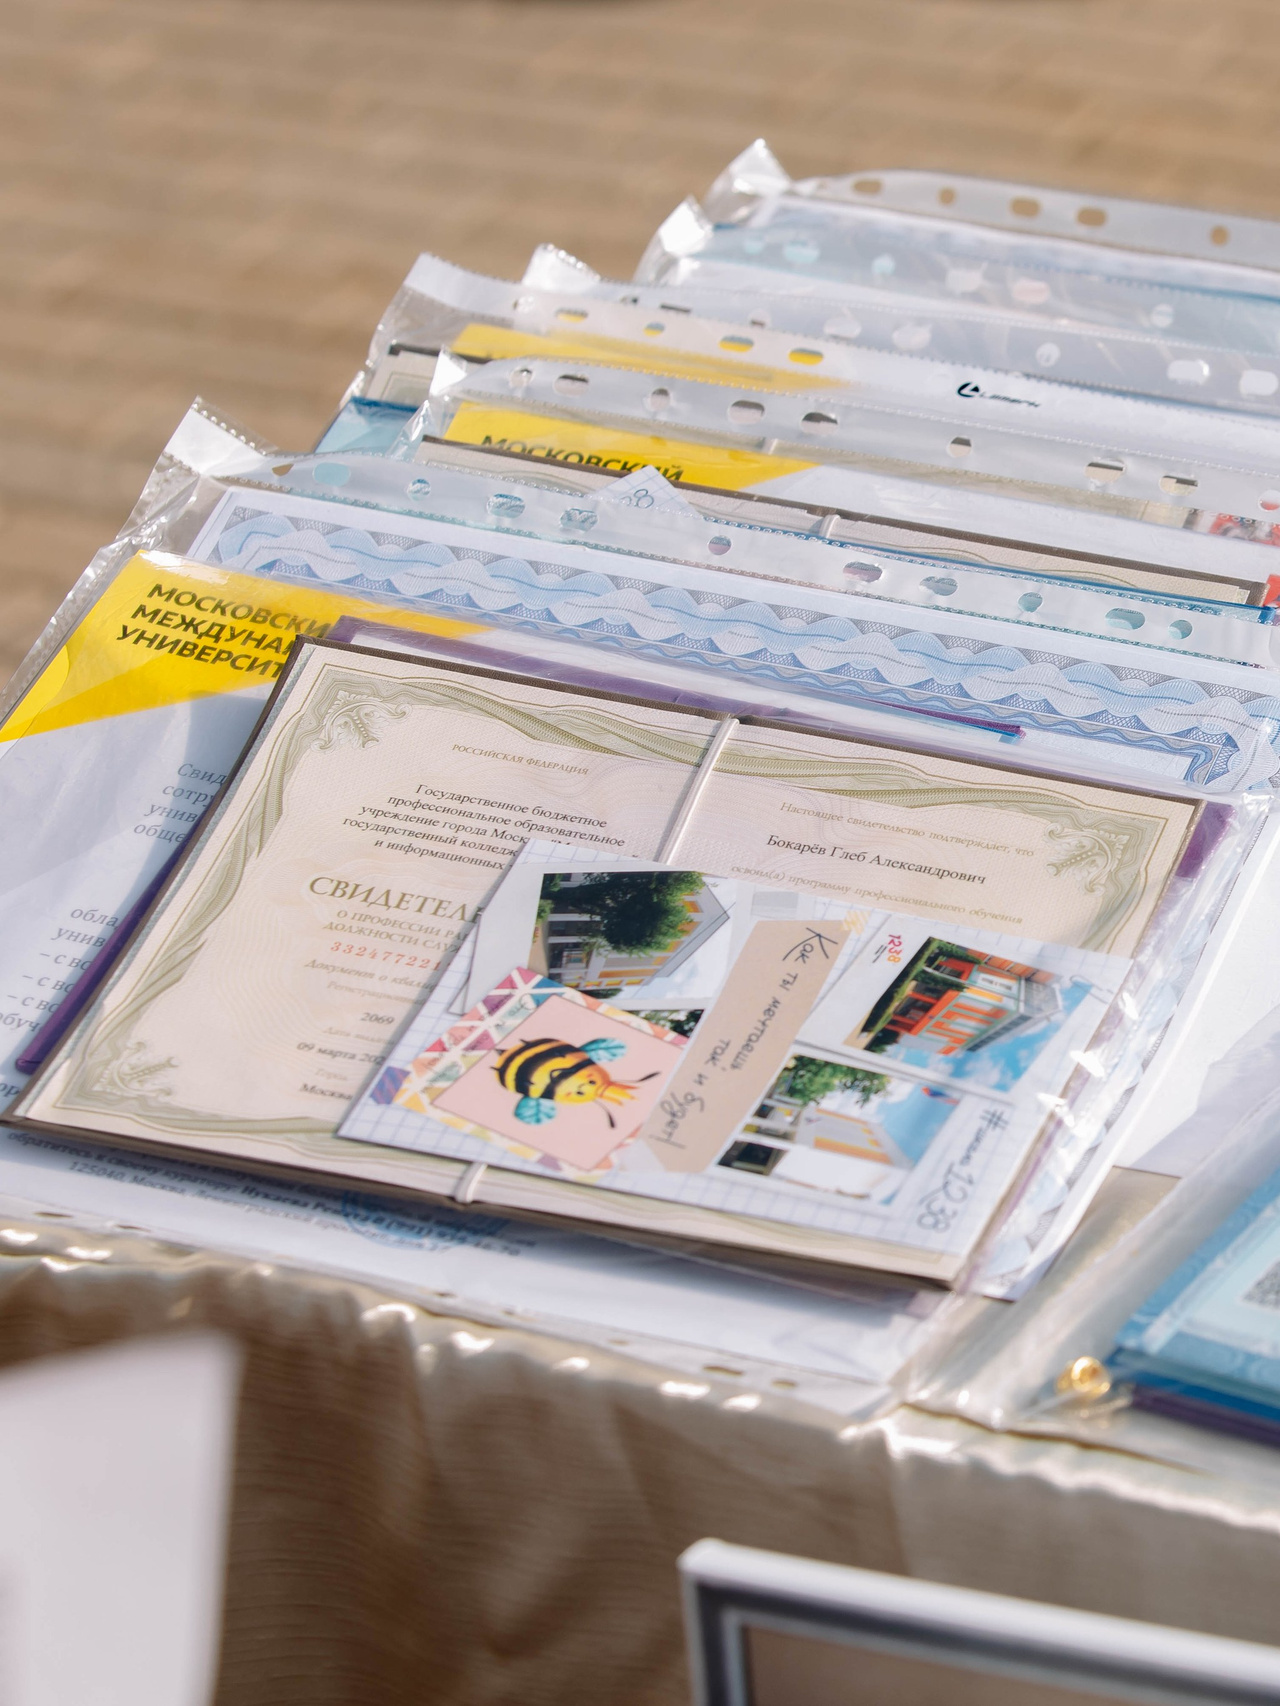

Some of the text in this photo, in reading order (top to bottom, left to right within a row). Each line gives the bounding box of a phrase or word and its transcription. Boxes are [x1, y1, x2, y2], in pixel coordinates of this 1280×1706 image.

[178, 763, 226, 786] Свид
[451, 744, 589, 776] РОССИЙСКАЯ ФЕДЕРАЦИЯ
[143, 804, 198, 822] унив
[415, 784, 608, 829] Государственное бюджетное
[133, 824, 187, 844] обще
[342, 817, 457, 845] государственный
[357, 806, 440, 829] учреждение
[442, 821, 488, 837] города
[387, 796, 625, 847] профессиональное образовательное
[780, 802, 1034, 858] Настоящее свидетельство подтверждает, что
[374, 839, 505, 870] и информационных
[767, 835, 987, 885] Бокарёв Глеб Александрович
[788, 876, 851, 896] программу
[855, 887, 965, 913] профессионального
[970, 908, 1023, 926] обучения
[70, 908, 119, 929] обла
[322, 921, 419, 945] ДОЛЖНОСТИ
[337, 910, 347, 919] О
[351, 912, 441, 937] ПРОФЕССИИ
[782, 927, 839, 965] Как
[887, 934, 902, 963] 1238
[779, 972, 799, 991] ты
[703, 1038, 731, 1068] так
[693, 1072, 709, 1086] и
